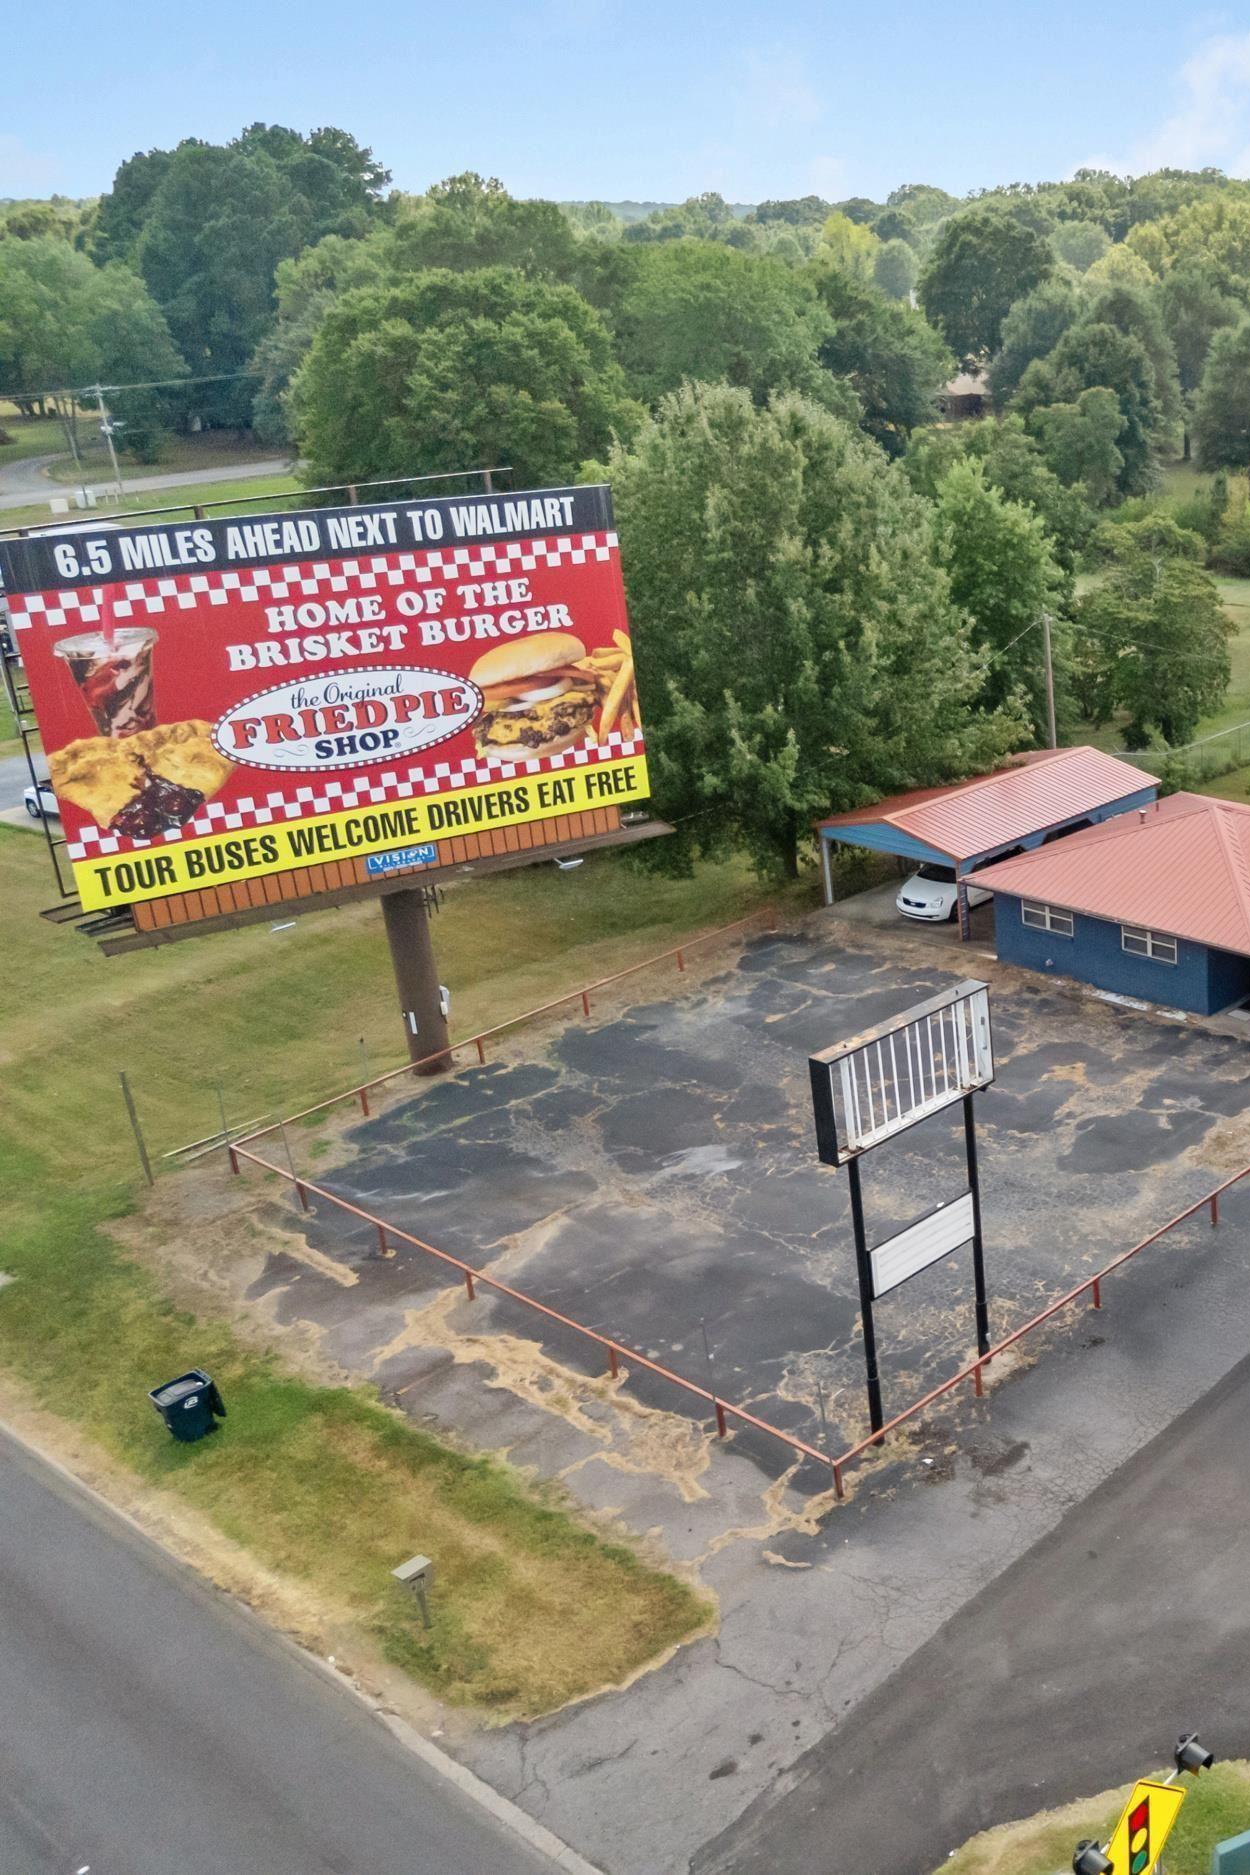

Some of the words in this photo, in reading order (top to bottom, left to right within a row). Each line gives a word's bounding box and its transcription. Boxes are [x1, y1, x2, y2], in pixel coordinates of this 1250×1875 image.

[53, 539, 112, 579] 6.5
[118, 528, 216, 571] MILES
[226, 520, 321, 560] AHEAD
[326, 512, 398, 550] NEXT
[406, 508, 444, 542] TO
[449, 496, 575, 537] WALMART
[264, 594, 387, 633] HOME
[396, 587, 447, 617] OF
[456, 577, 533, 610] THE
[225, 624, 408, 672] BRISKET
[418, 603, 574, 647] BURGER
[228, 699, 389, 750] FRIED
[390, 686, 471, 724] PIE
[291, 687, 321, 709] the
[323, 673, 404, 706] Original
[314, 728, 400, 760] SHOP
[94, 855, 178, 897] TOUR
[184, 834, 280, 879] BUSES
[286, 807, 421, 858] WELCOME
[426, 786, 530, 832] DRIVERS
[536, 777, 576, 809] EAT
[584, 765, 638, 800] FREE
[374, 846, 429, 865] VISION
